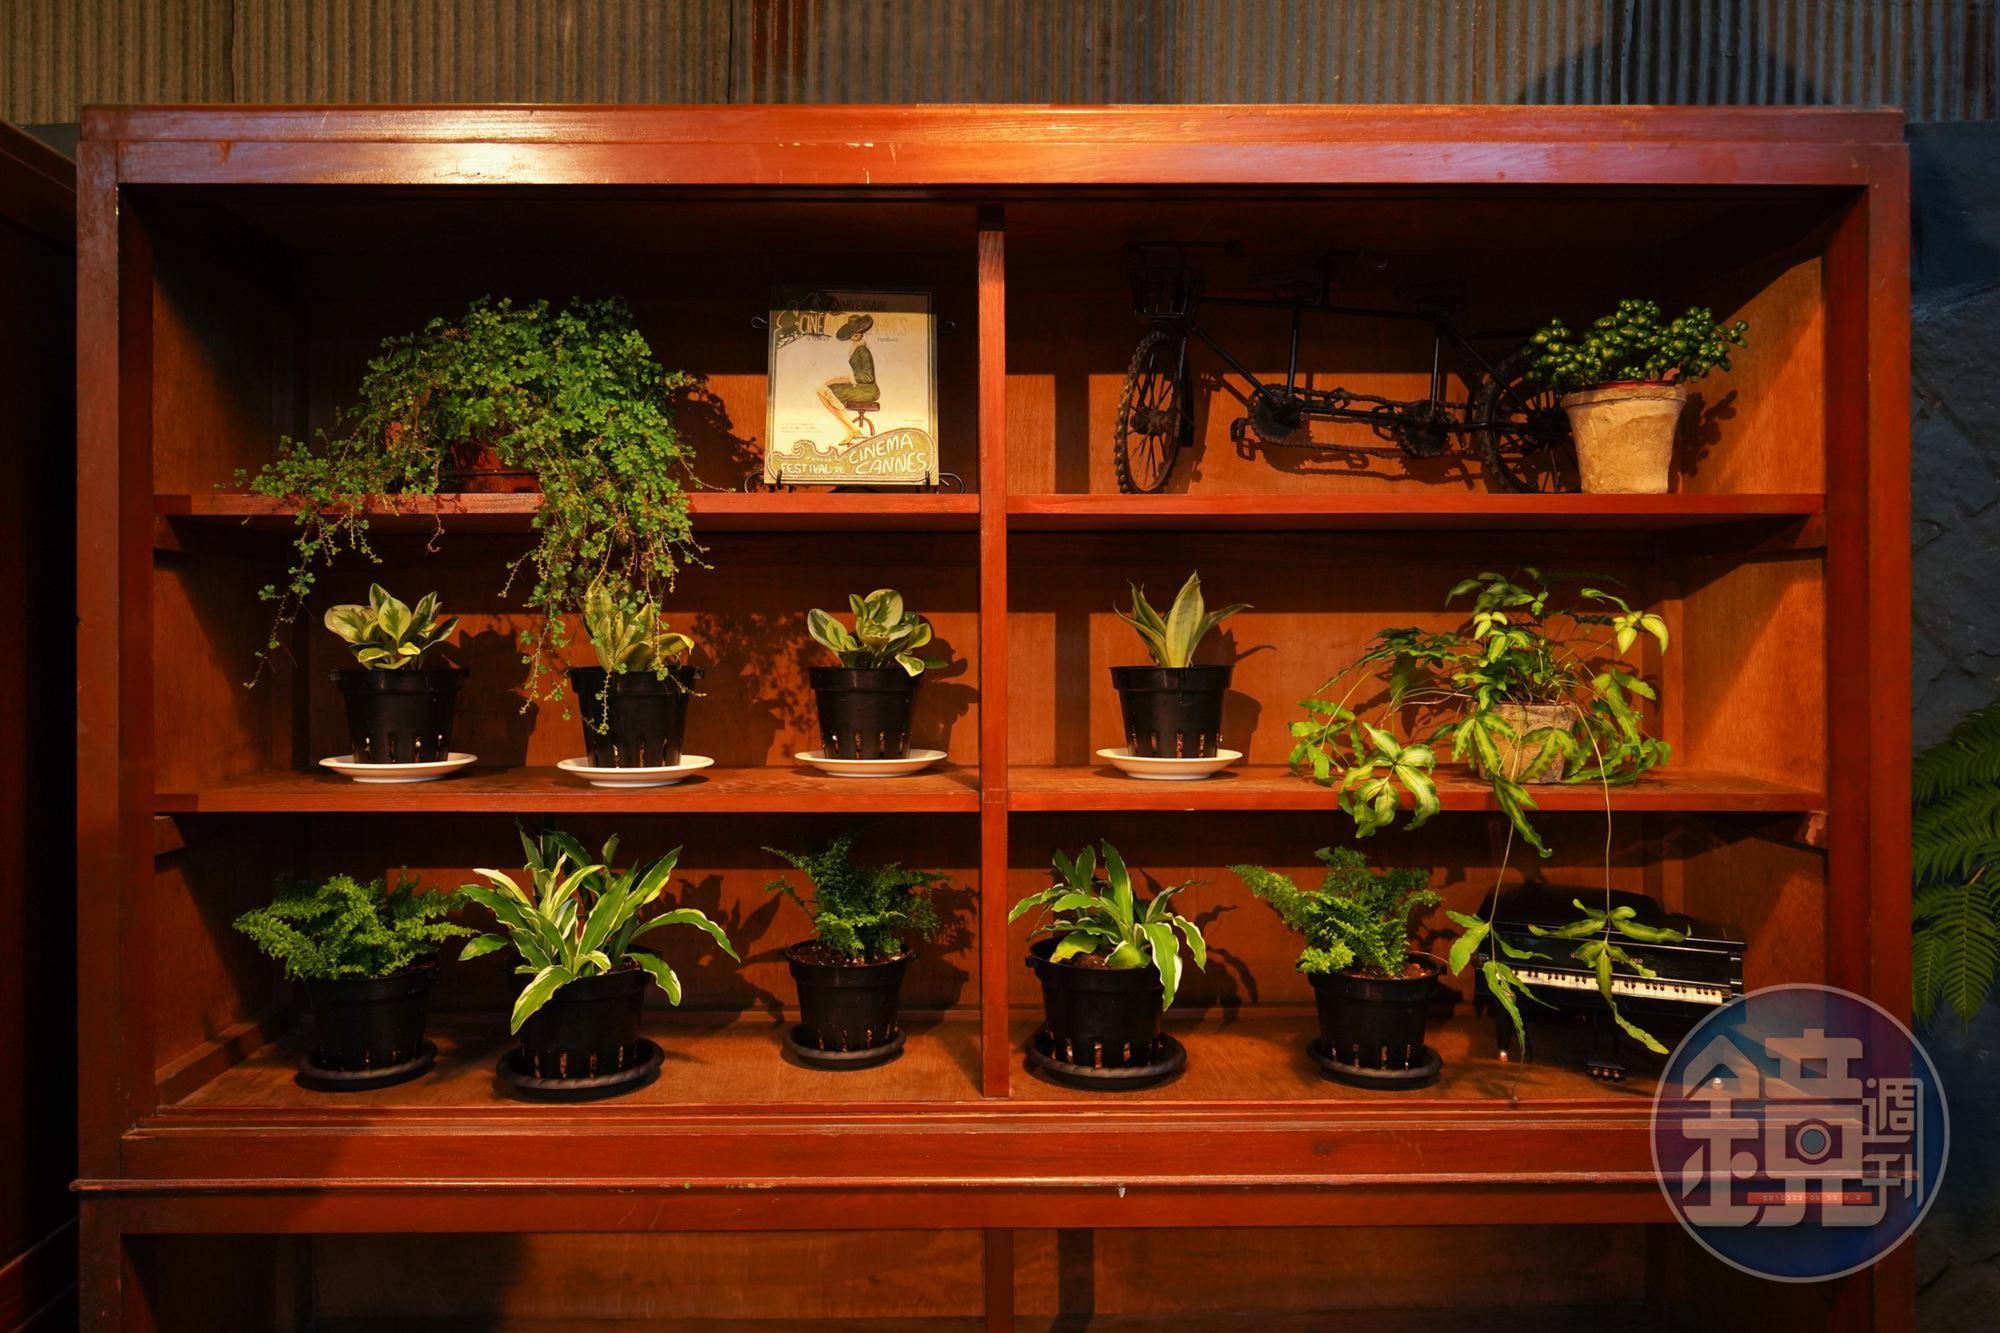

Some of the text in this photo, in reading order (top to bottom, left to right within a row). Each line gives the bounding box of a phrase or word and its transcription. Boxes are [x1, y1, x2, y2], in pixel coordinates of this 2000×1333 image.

[848, 432, 914, 464] CINEMA
[781, 463, 832, 474] FESTIVAL
[855, 452, 928, 475] CANNES
